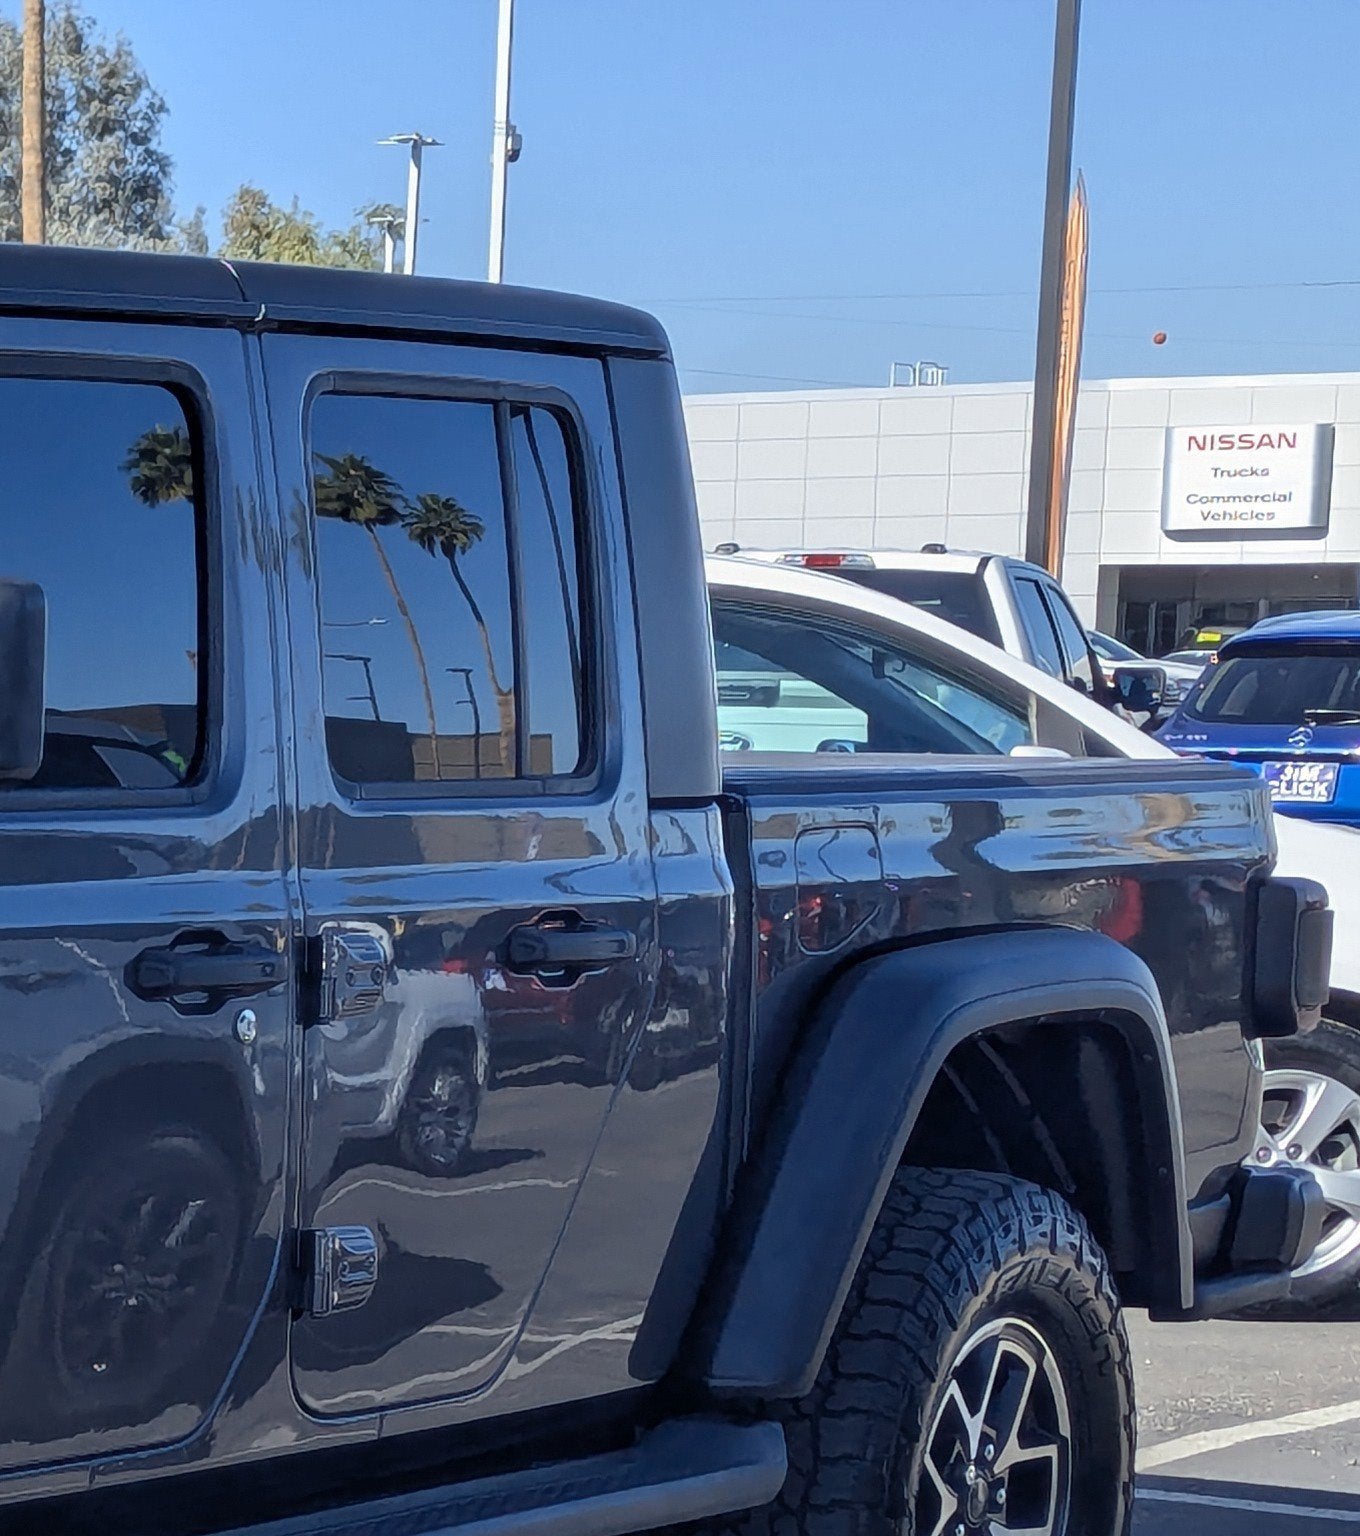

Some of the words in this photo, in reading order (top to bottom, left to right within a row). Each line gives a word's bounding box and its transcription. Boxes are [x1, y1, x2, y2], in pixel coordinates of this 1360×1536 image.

[1187, 432, 1297, 452] NISSAN
[1211, 466, 1270, 478] Trucks
[1186, 491, 1292, 505] Commercial
[1200, 510, 1275, 521] Vehicles
[1279, 763, 1321, 781] JIM
[1268, 781, 1329, 799] CLICK
